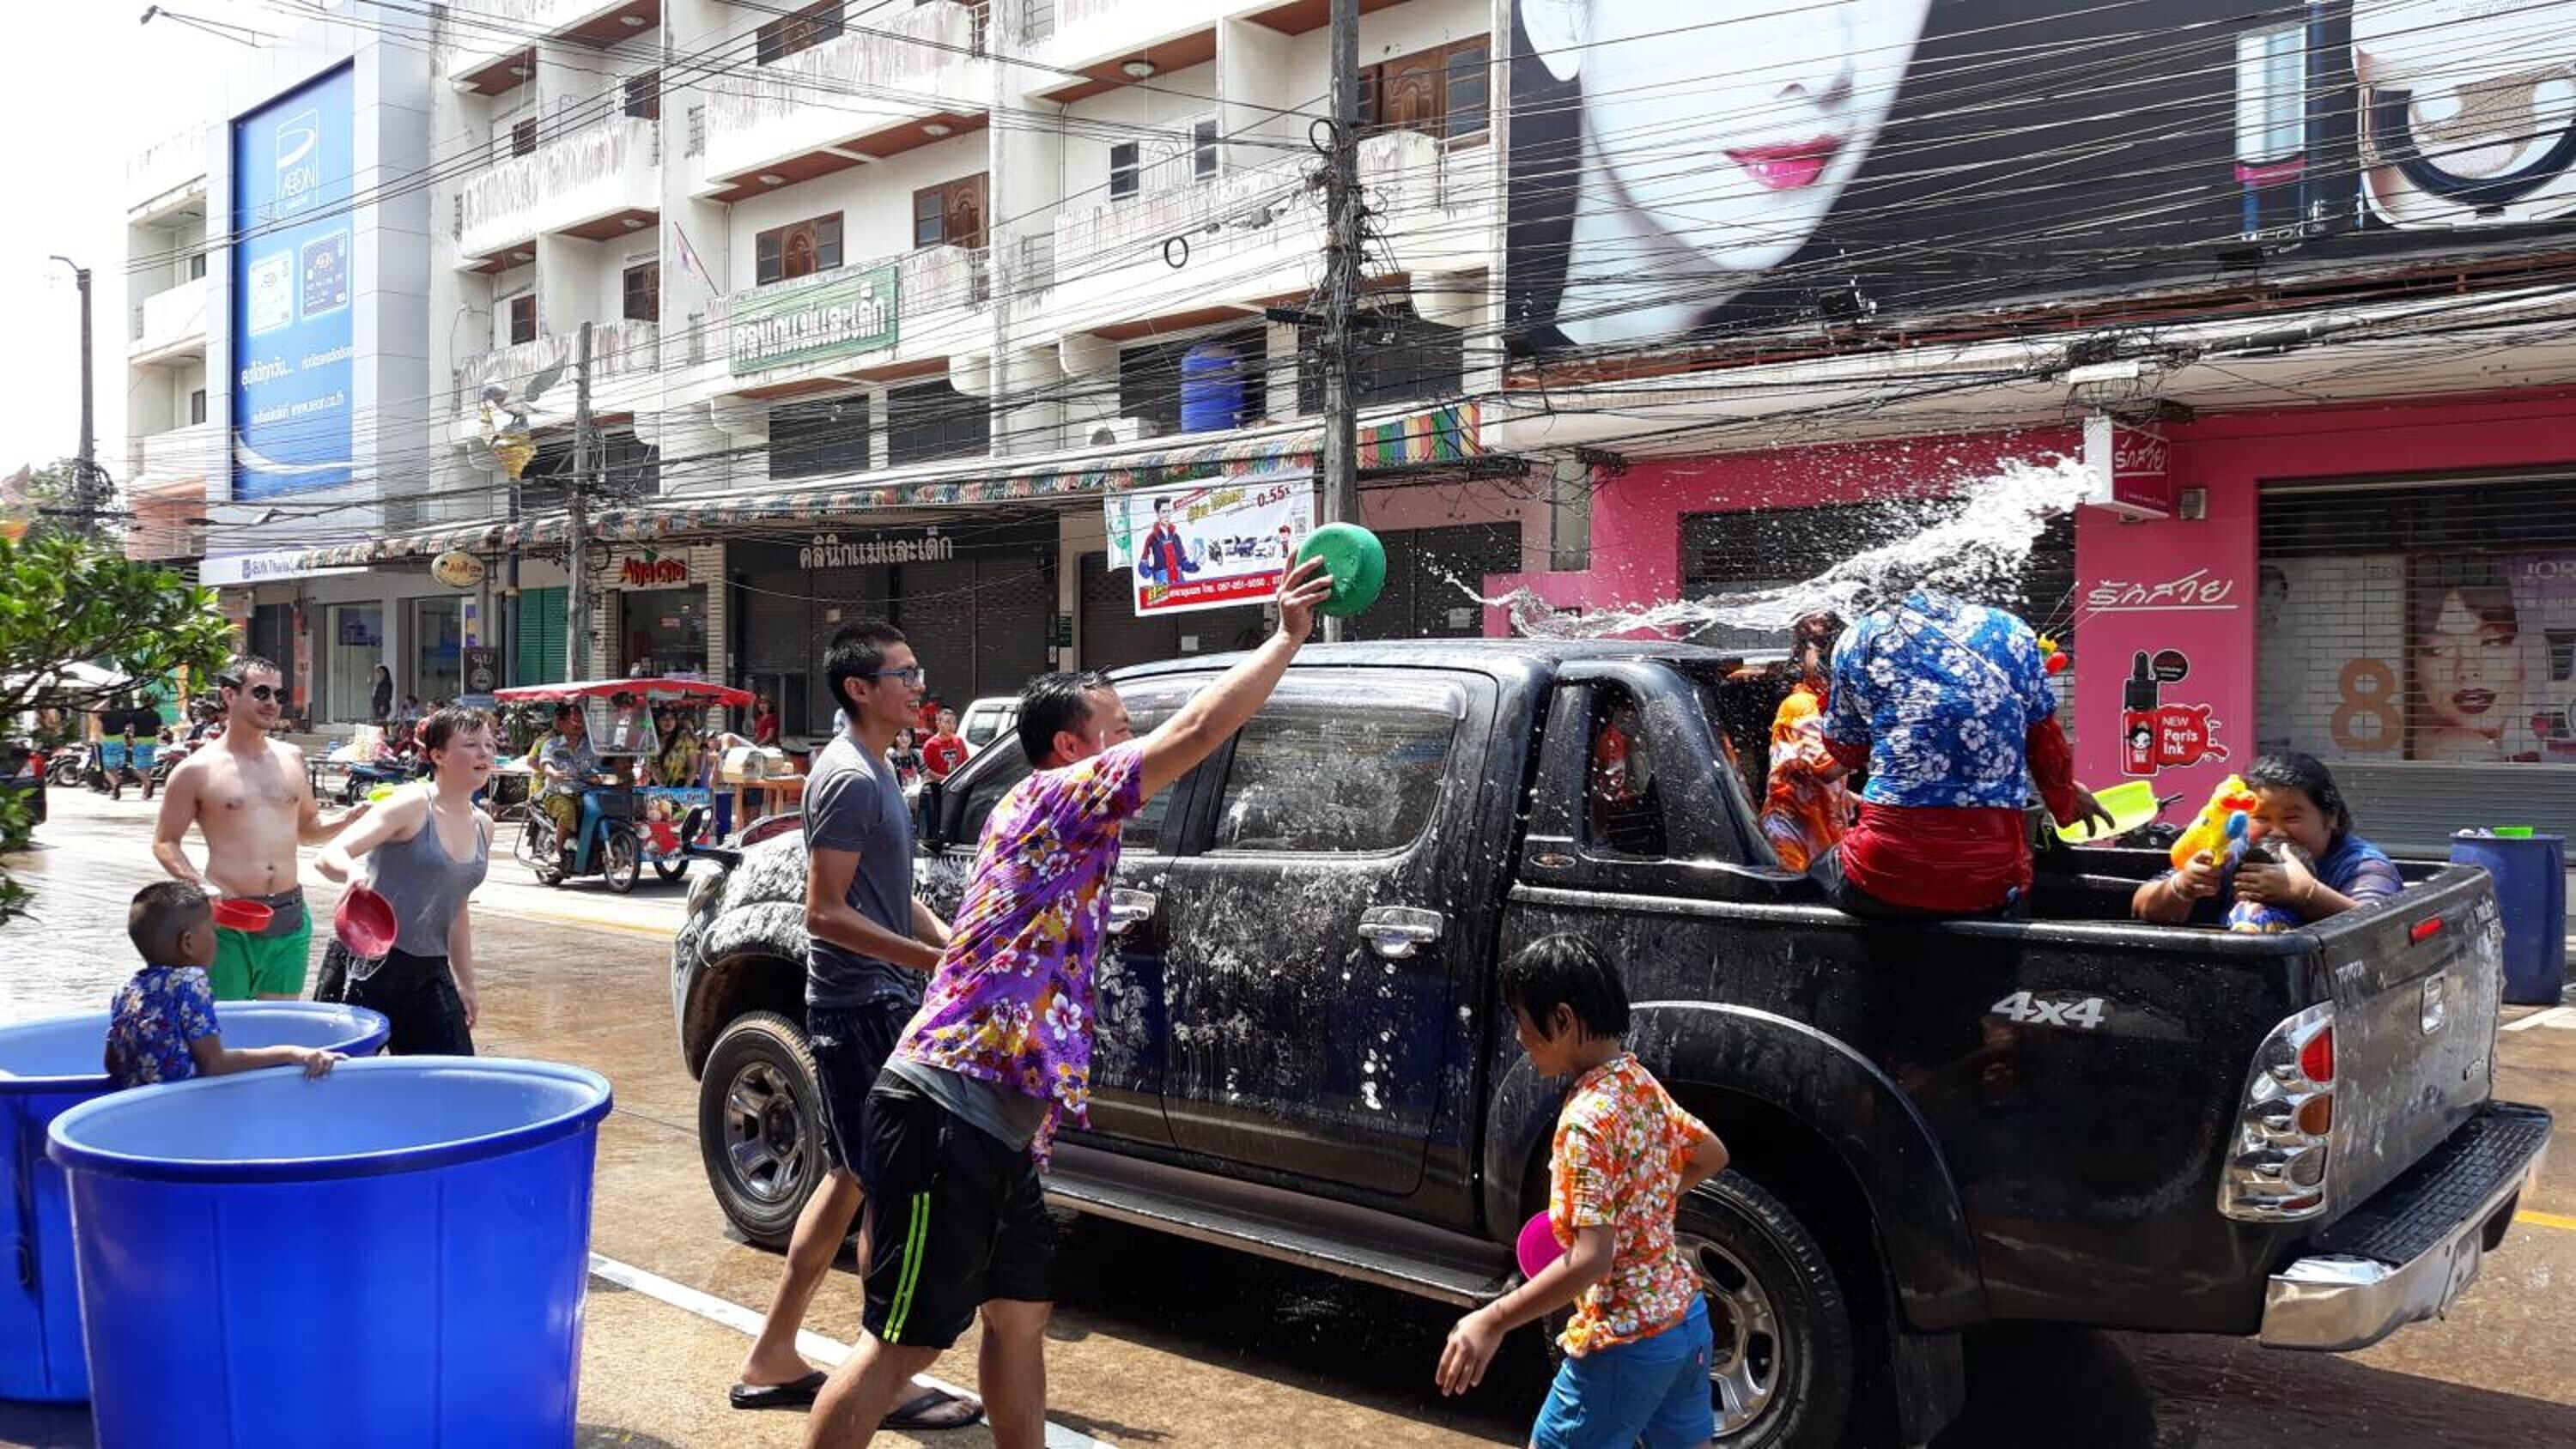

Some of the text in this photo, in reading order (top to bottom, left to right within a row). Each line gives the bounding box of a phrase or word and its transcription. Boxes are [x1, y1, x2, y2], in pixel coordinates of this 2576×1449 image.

[799, 526, 953, 568] คลินิกแม่และเด็ก
[2162, 716, 2189, 727] NEW
[2330, 658, 2403, 753] 8
[2164, 741, 2185, 755] Ink
[1991, 991, 2105, 1029] 4x4
